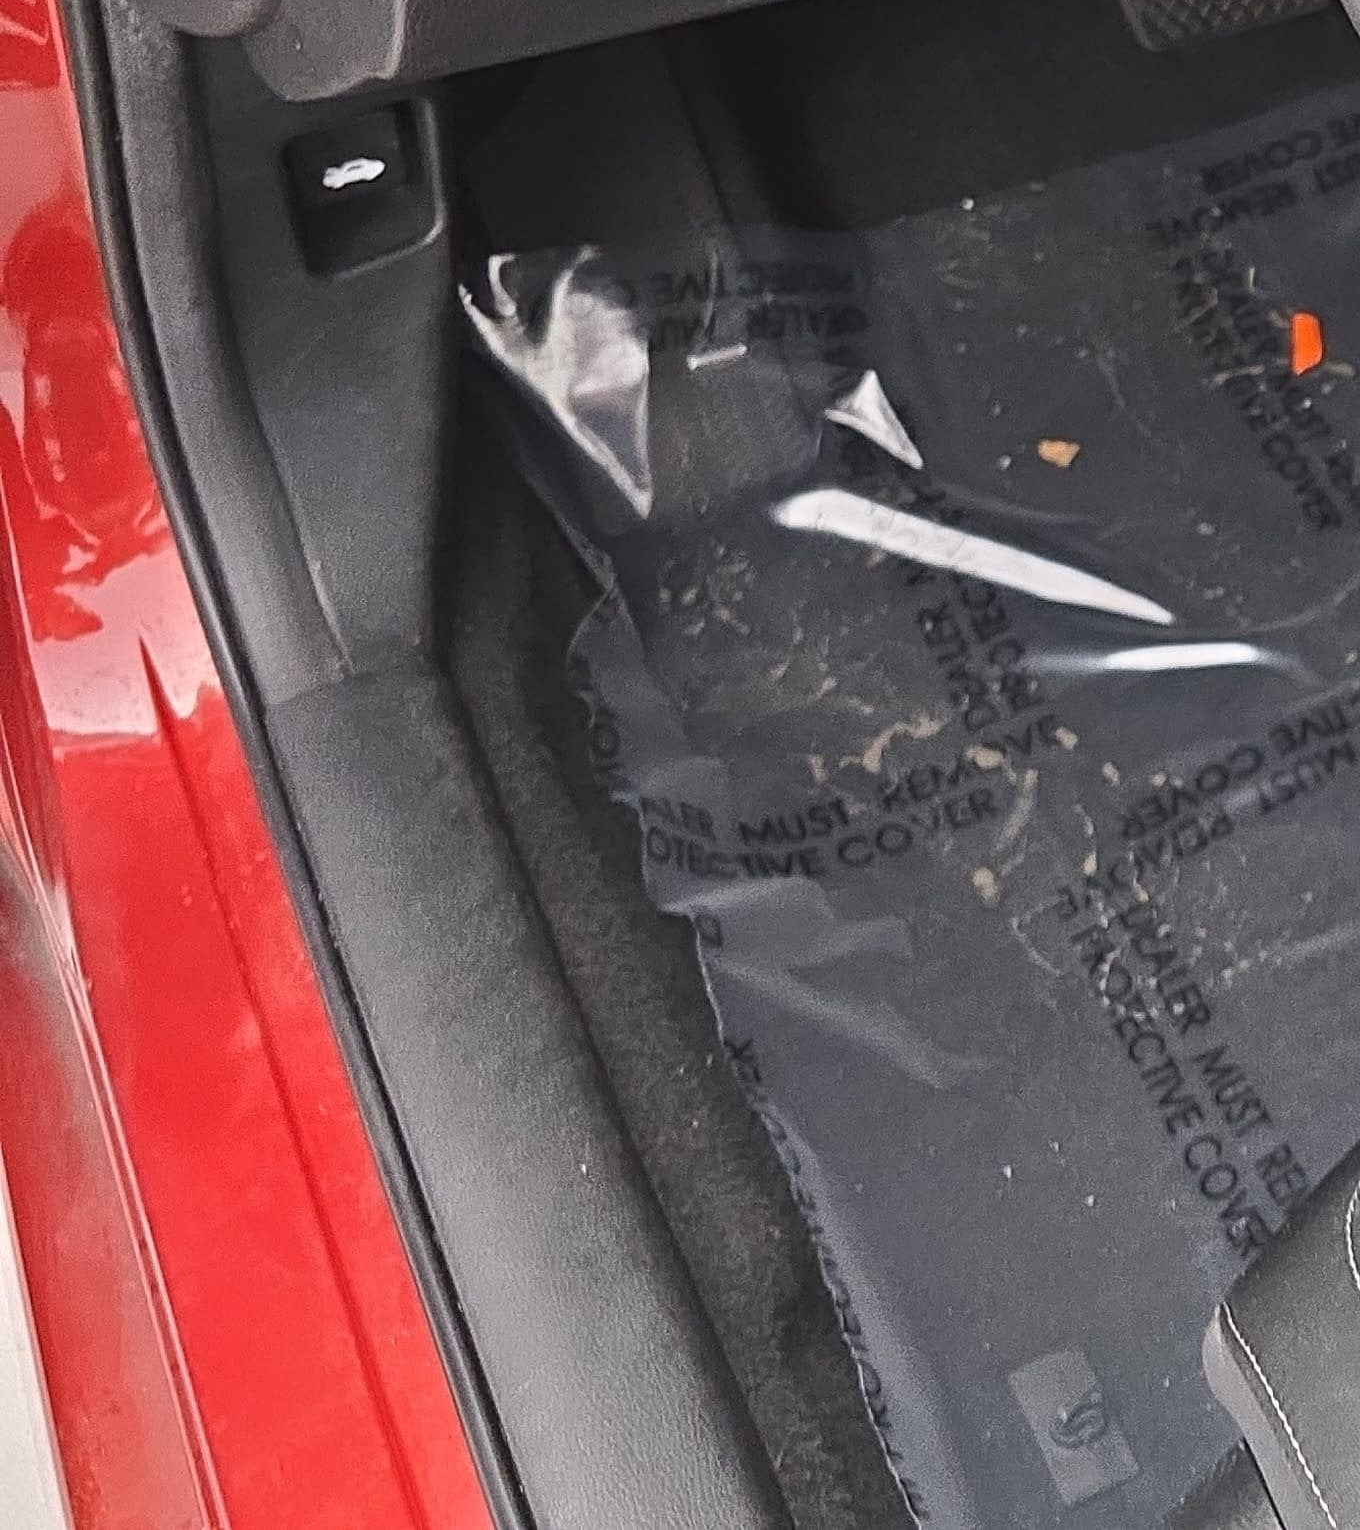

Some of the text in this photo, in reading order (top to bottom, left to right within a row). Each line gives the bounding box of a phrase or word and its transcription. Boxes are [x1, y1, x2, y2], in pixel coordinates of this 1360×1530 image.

[737, 796, 851, 847] MUST
[835, 787, 1001, 867] COVER
[1117, 743, 1267, 843] COVER
[1186, 1041, 1274, 1140] MUST
